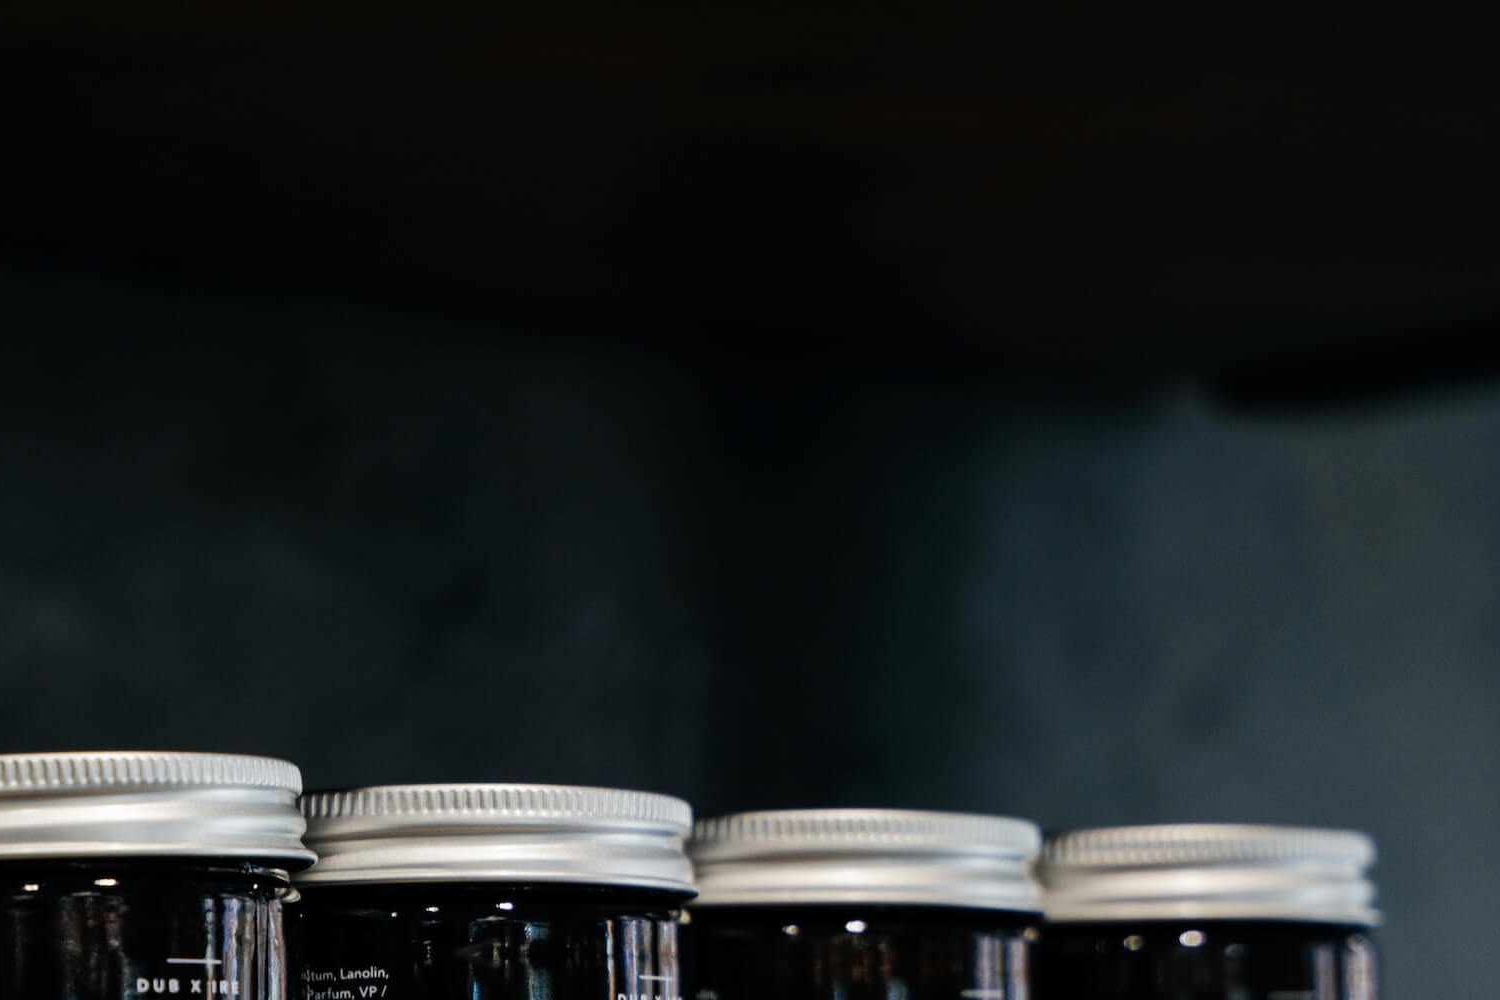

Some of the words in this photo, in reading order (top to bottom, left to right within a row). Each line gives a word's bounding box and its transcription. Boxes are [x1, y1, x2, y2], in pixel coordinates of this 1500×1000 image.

[340, 965, 389, 980] Lanolin,
[136, 977, 180, 993] DUB
[190, 979, 202, 994] X
[359, 984, 378, 998] VP
